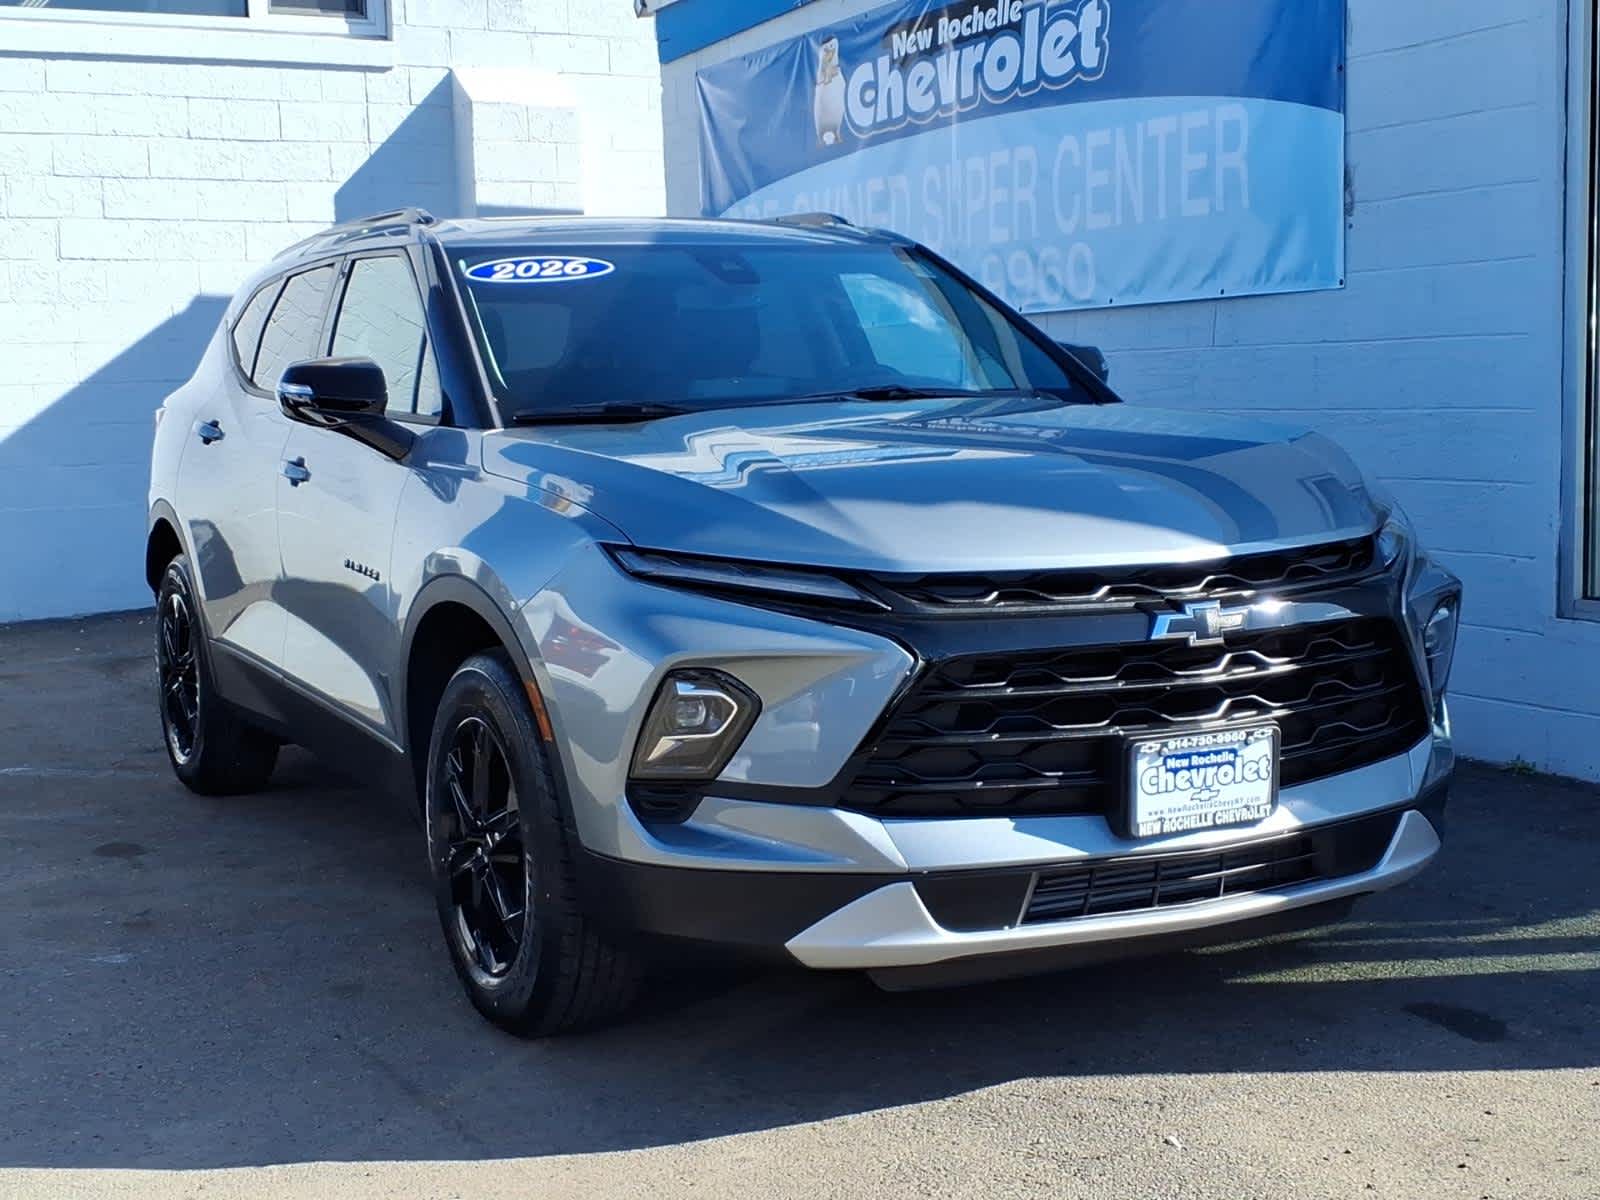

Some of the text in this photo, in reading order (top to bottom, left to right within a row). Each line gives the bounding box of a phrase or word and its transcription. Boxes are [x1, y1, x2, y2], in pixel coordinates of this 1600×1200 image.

[891, 0, 1023, 60] New Rochelle
[847, 0, 1103, 128] Chevrolet
[921, 145, 1041, 251] SUPER
[1051, 102, 1251, 236] CENTER
[491, 259, 589, 280] 2026
[981, 241, 1097, 301] 9960
[1141, 754, 1271, 795] Chevrolet
[1166, 751, 1235, 769] New Rochelle
[1139, 804, 1272, 837] NEW ROCHELLE CHEVROLET
